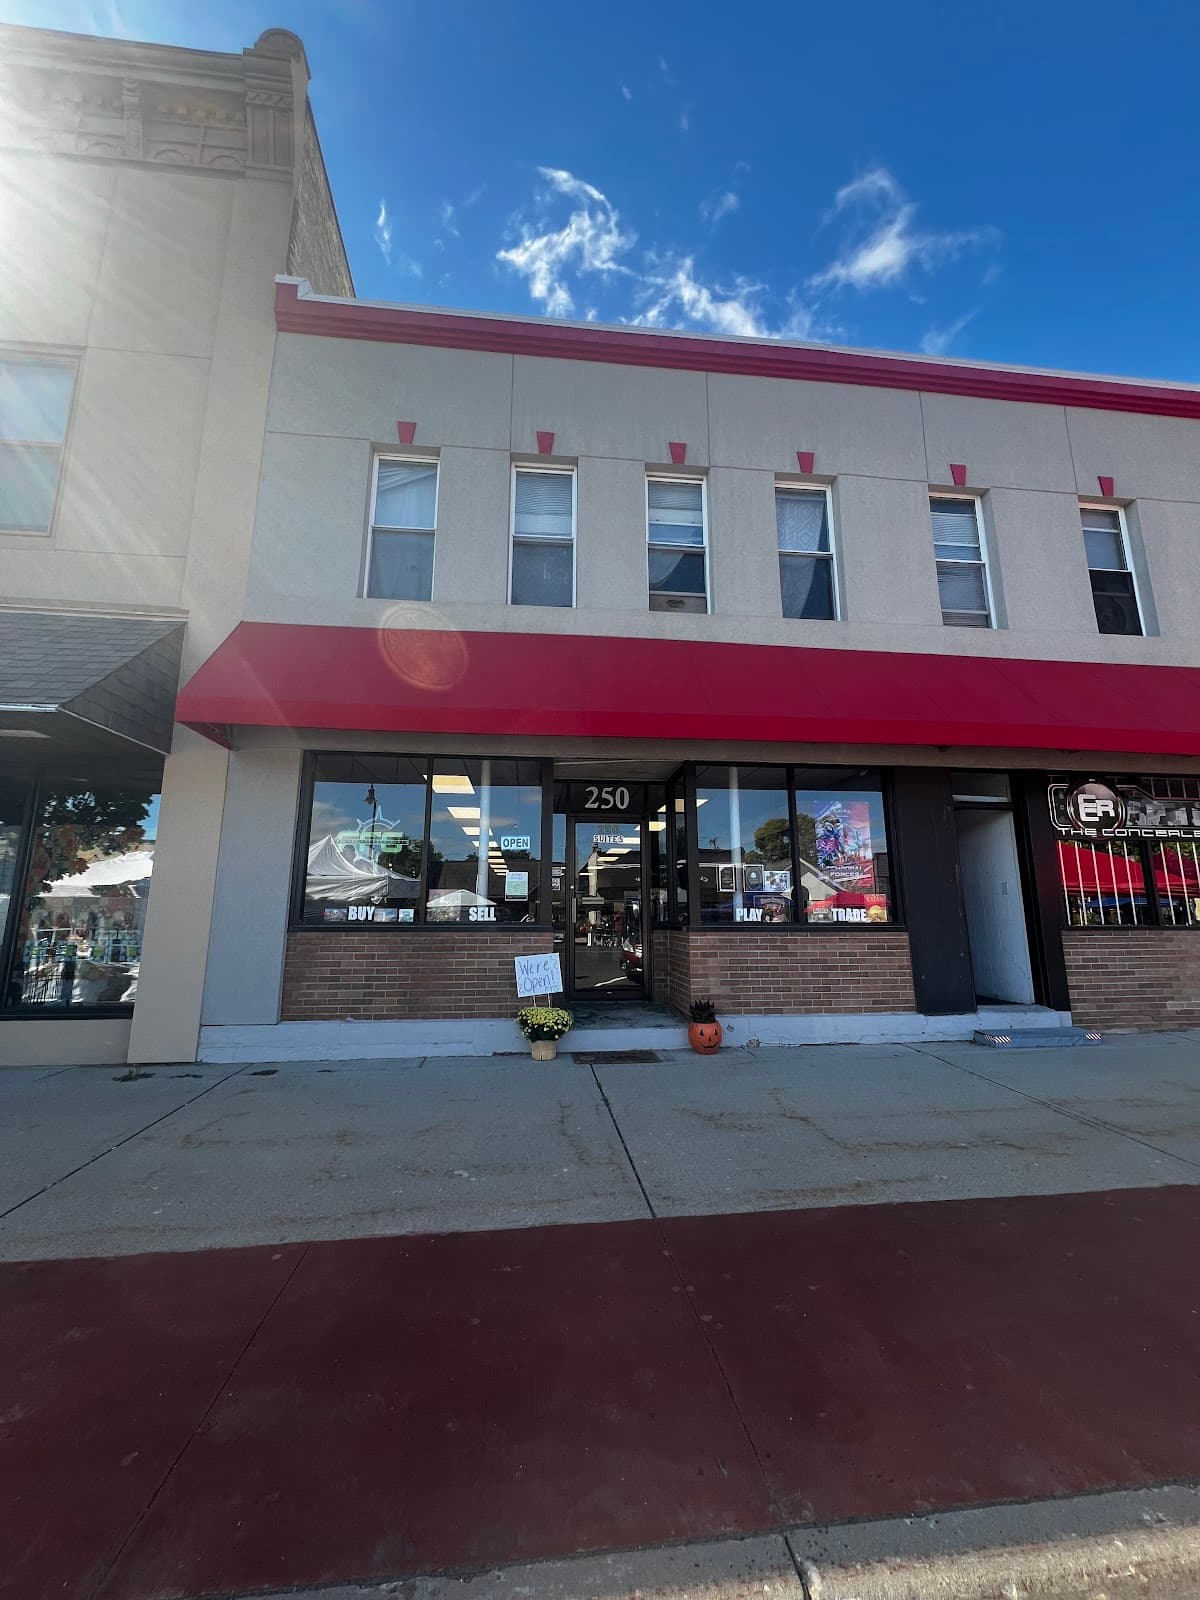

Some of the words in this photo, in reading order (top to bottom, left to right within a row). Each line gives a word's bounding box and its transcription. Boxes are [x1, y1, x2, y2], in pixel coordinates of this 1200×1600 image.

[585, 786, 630, 810] 250
[1077, 794, 1116, 822] ER
[1058, 828, 1097, 836] THE
[503, 838, 529, 848] OPEN
[348, 905, 375, 921] BUY
[469, 906, 497, 922] SELL
[735, 907, 763, 922] PLAY
[831, 907, 867, 922] TRADE
